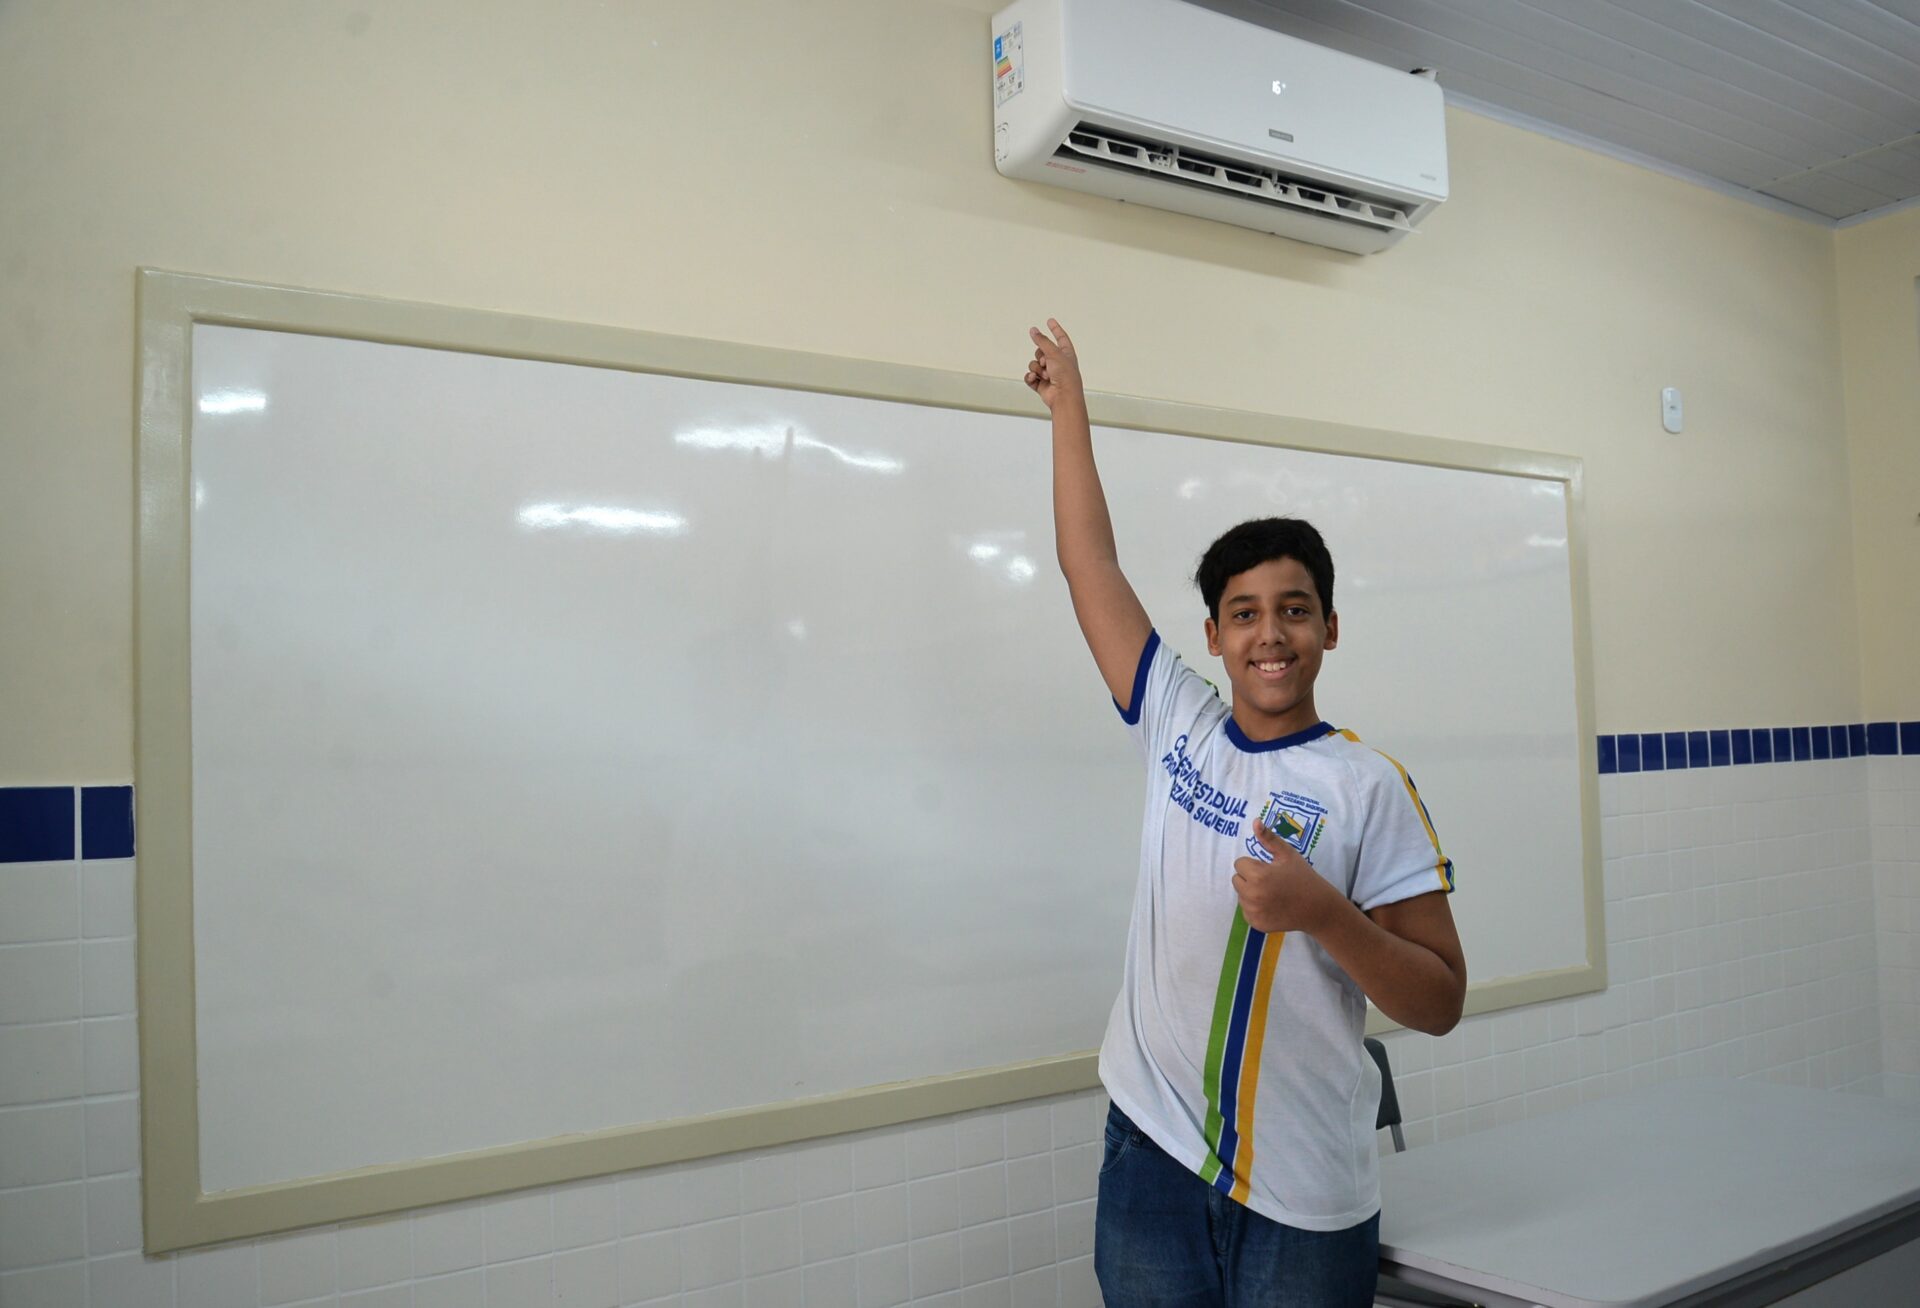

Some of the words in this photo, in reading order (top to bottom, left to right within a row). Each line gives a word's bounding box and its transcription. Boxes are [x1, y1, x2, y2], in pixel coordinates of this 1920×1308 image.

[1170, 779, 1195, 814] EZÁRO
[1174, 734, 1201, 788] COÉGIO
[1193, 780, 1248, 819] ESTDUAL
